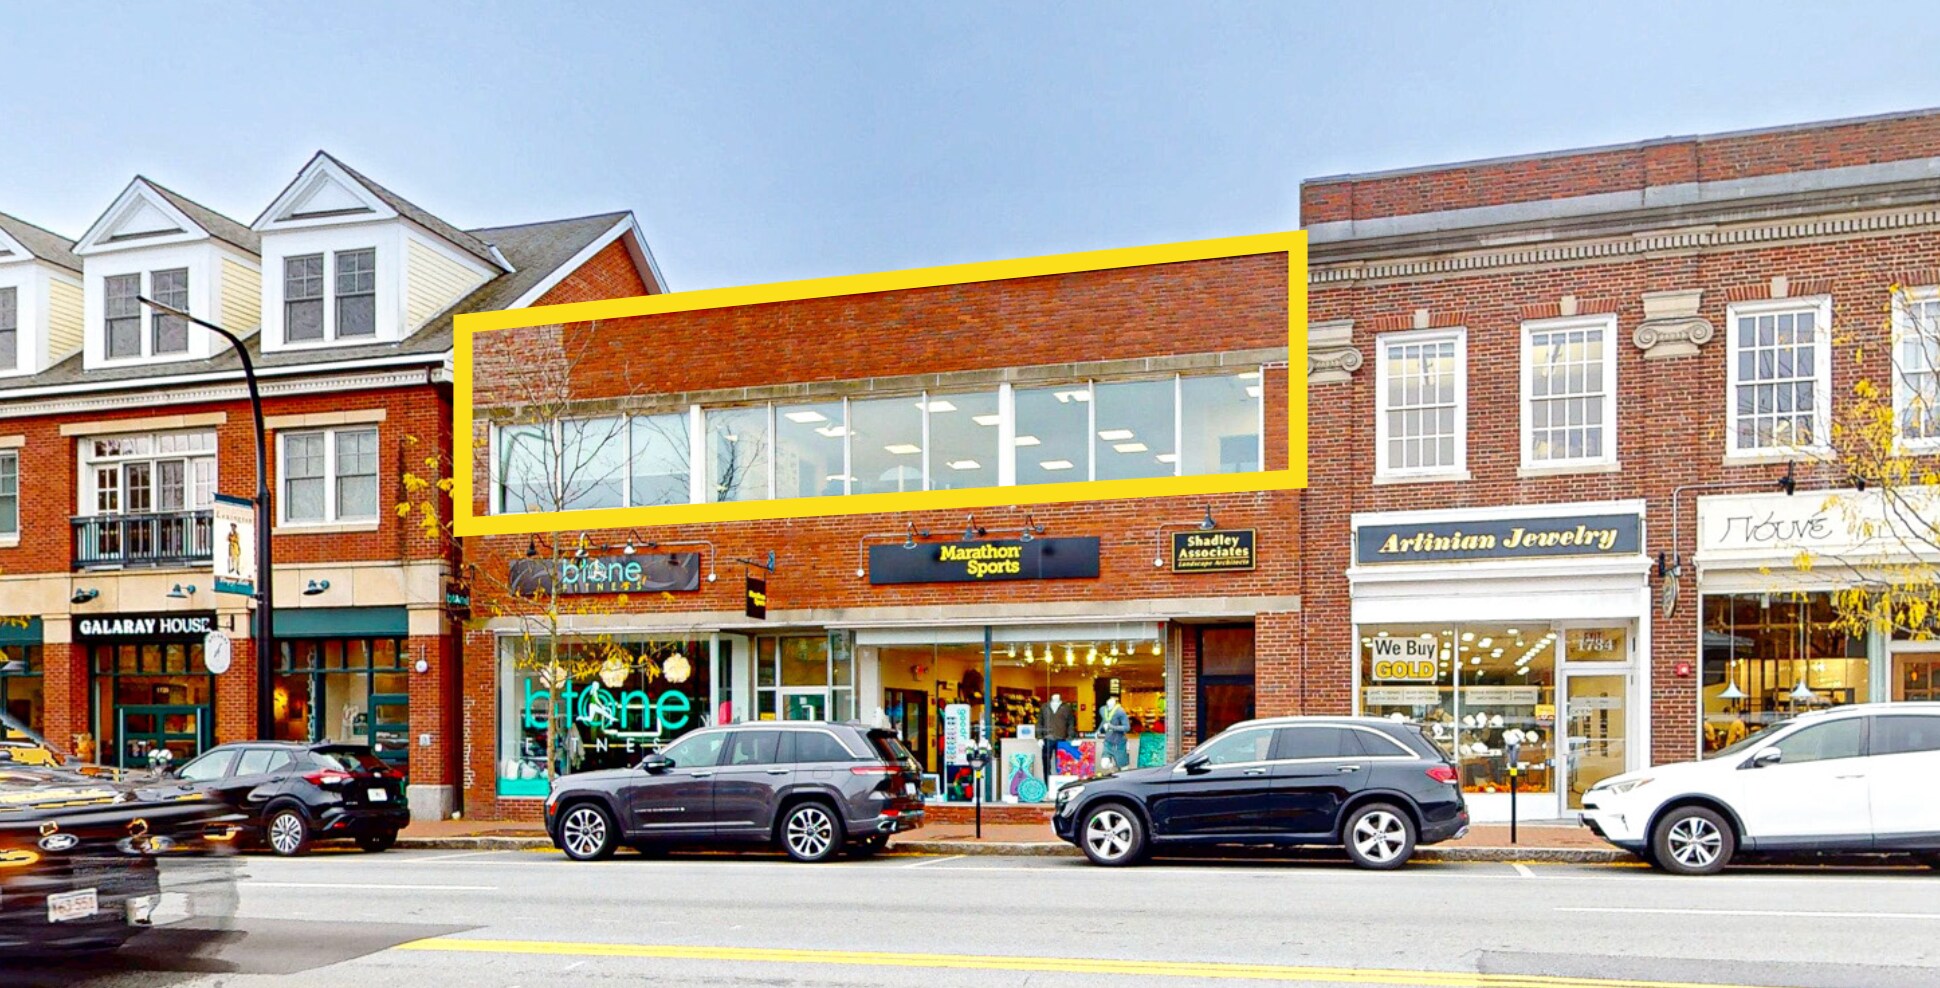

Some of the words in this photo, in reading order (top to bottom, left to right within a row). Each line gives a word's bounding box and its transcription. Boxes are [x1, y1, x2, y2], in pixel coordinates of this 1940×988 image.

[1187, 534, 1239, 547] Shadley
[1379, 531, 1495, 553] Artinian
[1503, 525, 1618, 549] Jewelry
[940, 544, 1020, 560] Marathon
[1179, 546, 1249, 558] Associates
[967, 559, 1020, 577] Sports
[79, 618, 156, 635] GALARAY
[160, 617, 210, 633] HOUSE
[1375, 640, 1401, 655] We
[1406, 640, 1435, 659] Buy
[1375, 660, 1435, 679] GOLD
[524, 677, 691, 730] btone
